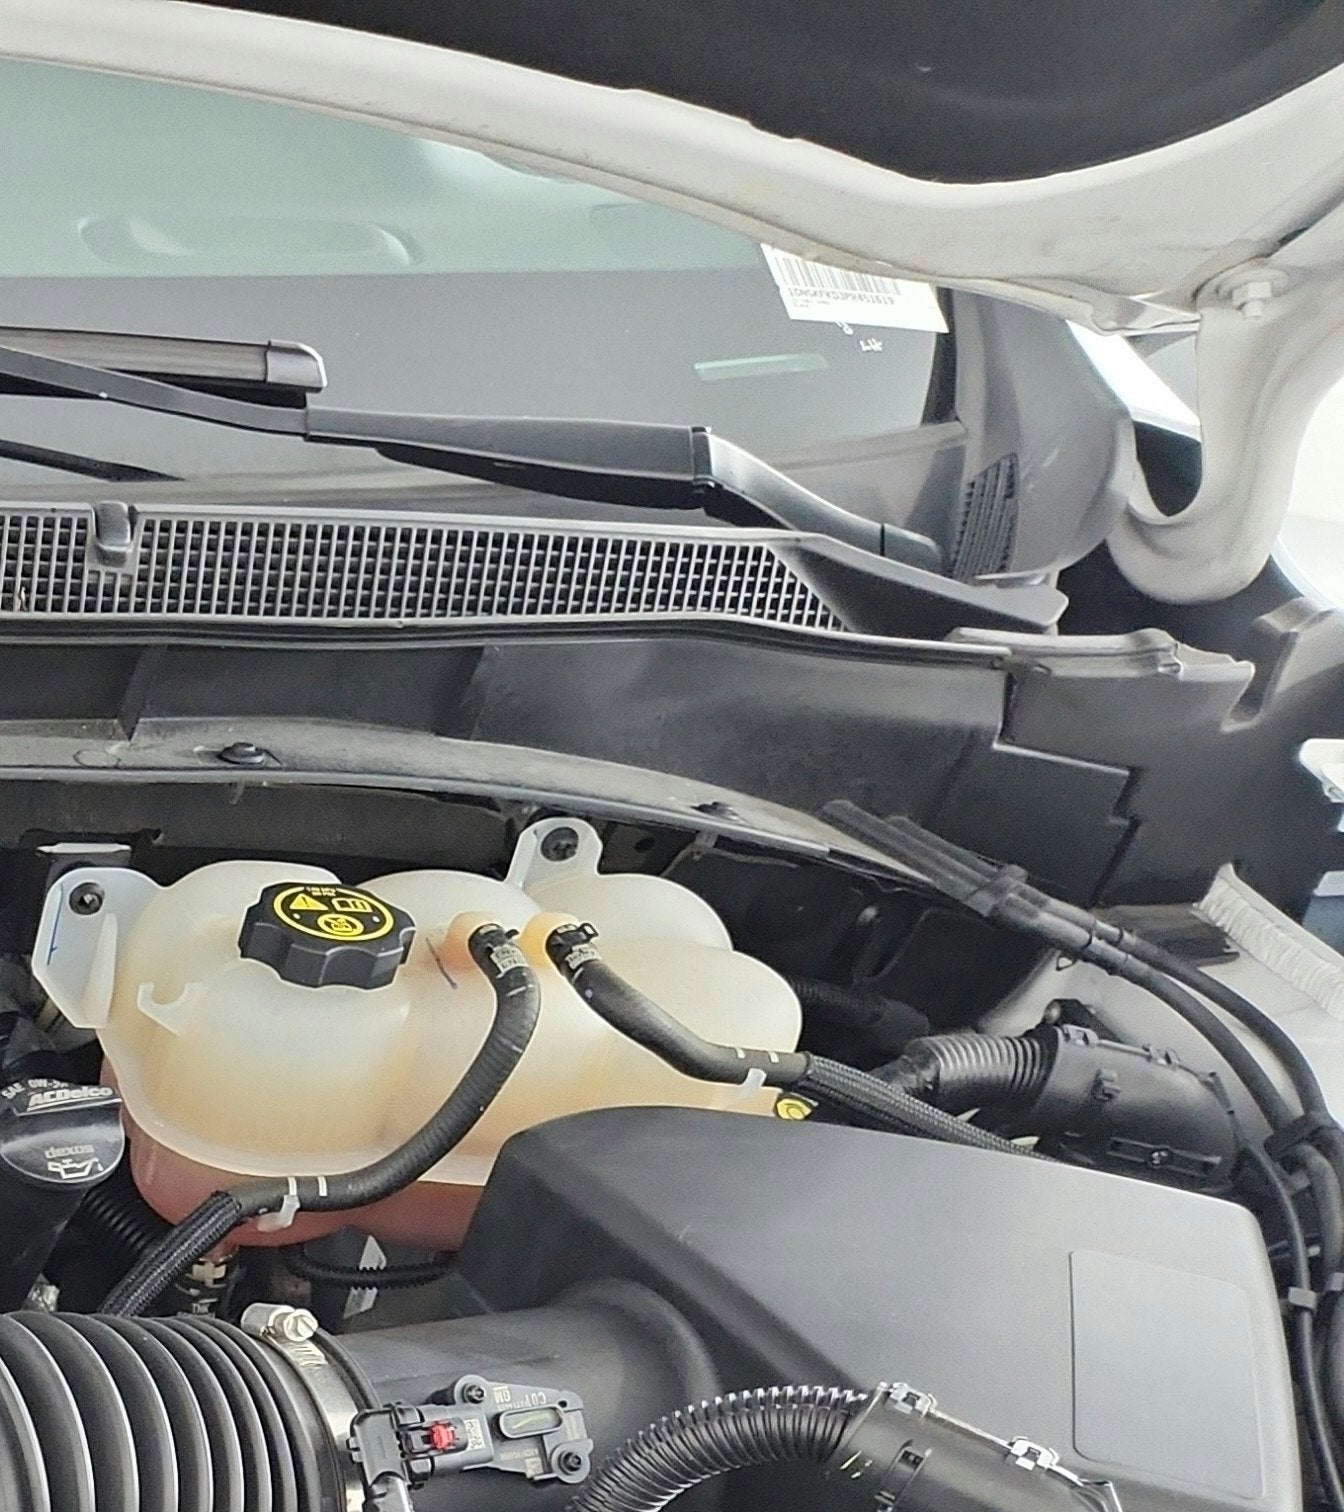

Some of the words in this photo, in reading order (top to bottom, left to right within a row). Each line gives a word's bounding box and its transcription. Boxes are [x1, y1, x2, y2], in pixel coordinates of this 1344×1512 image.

[2, 1083, 25, 1099] SAE
[29, 1086, 113, 1107] ACDelco
[46, 1145, 94, 1158] dexos
